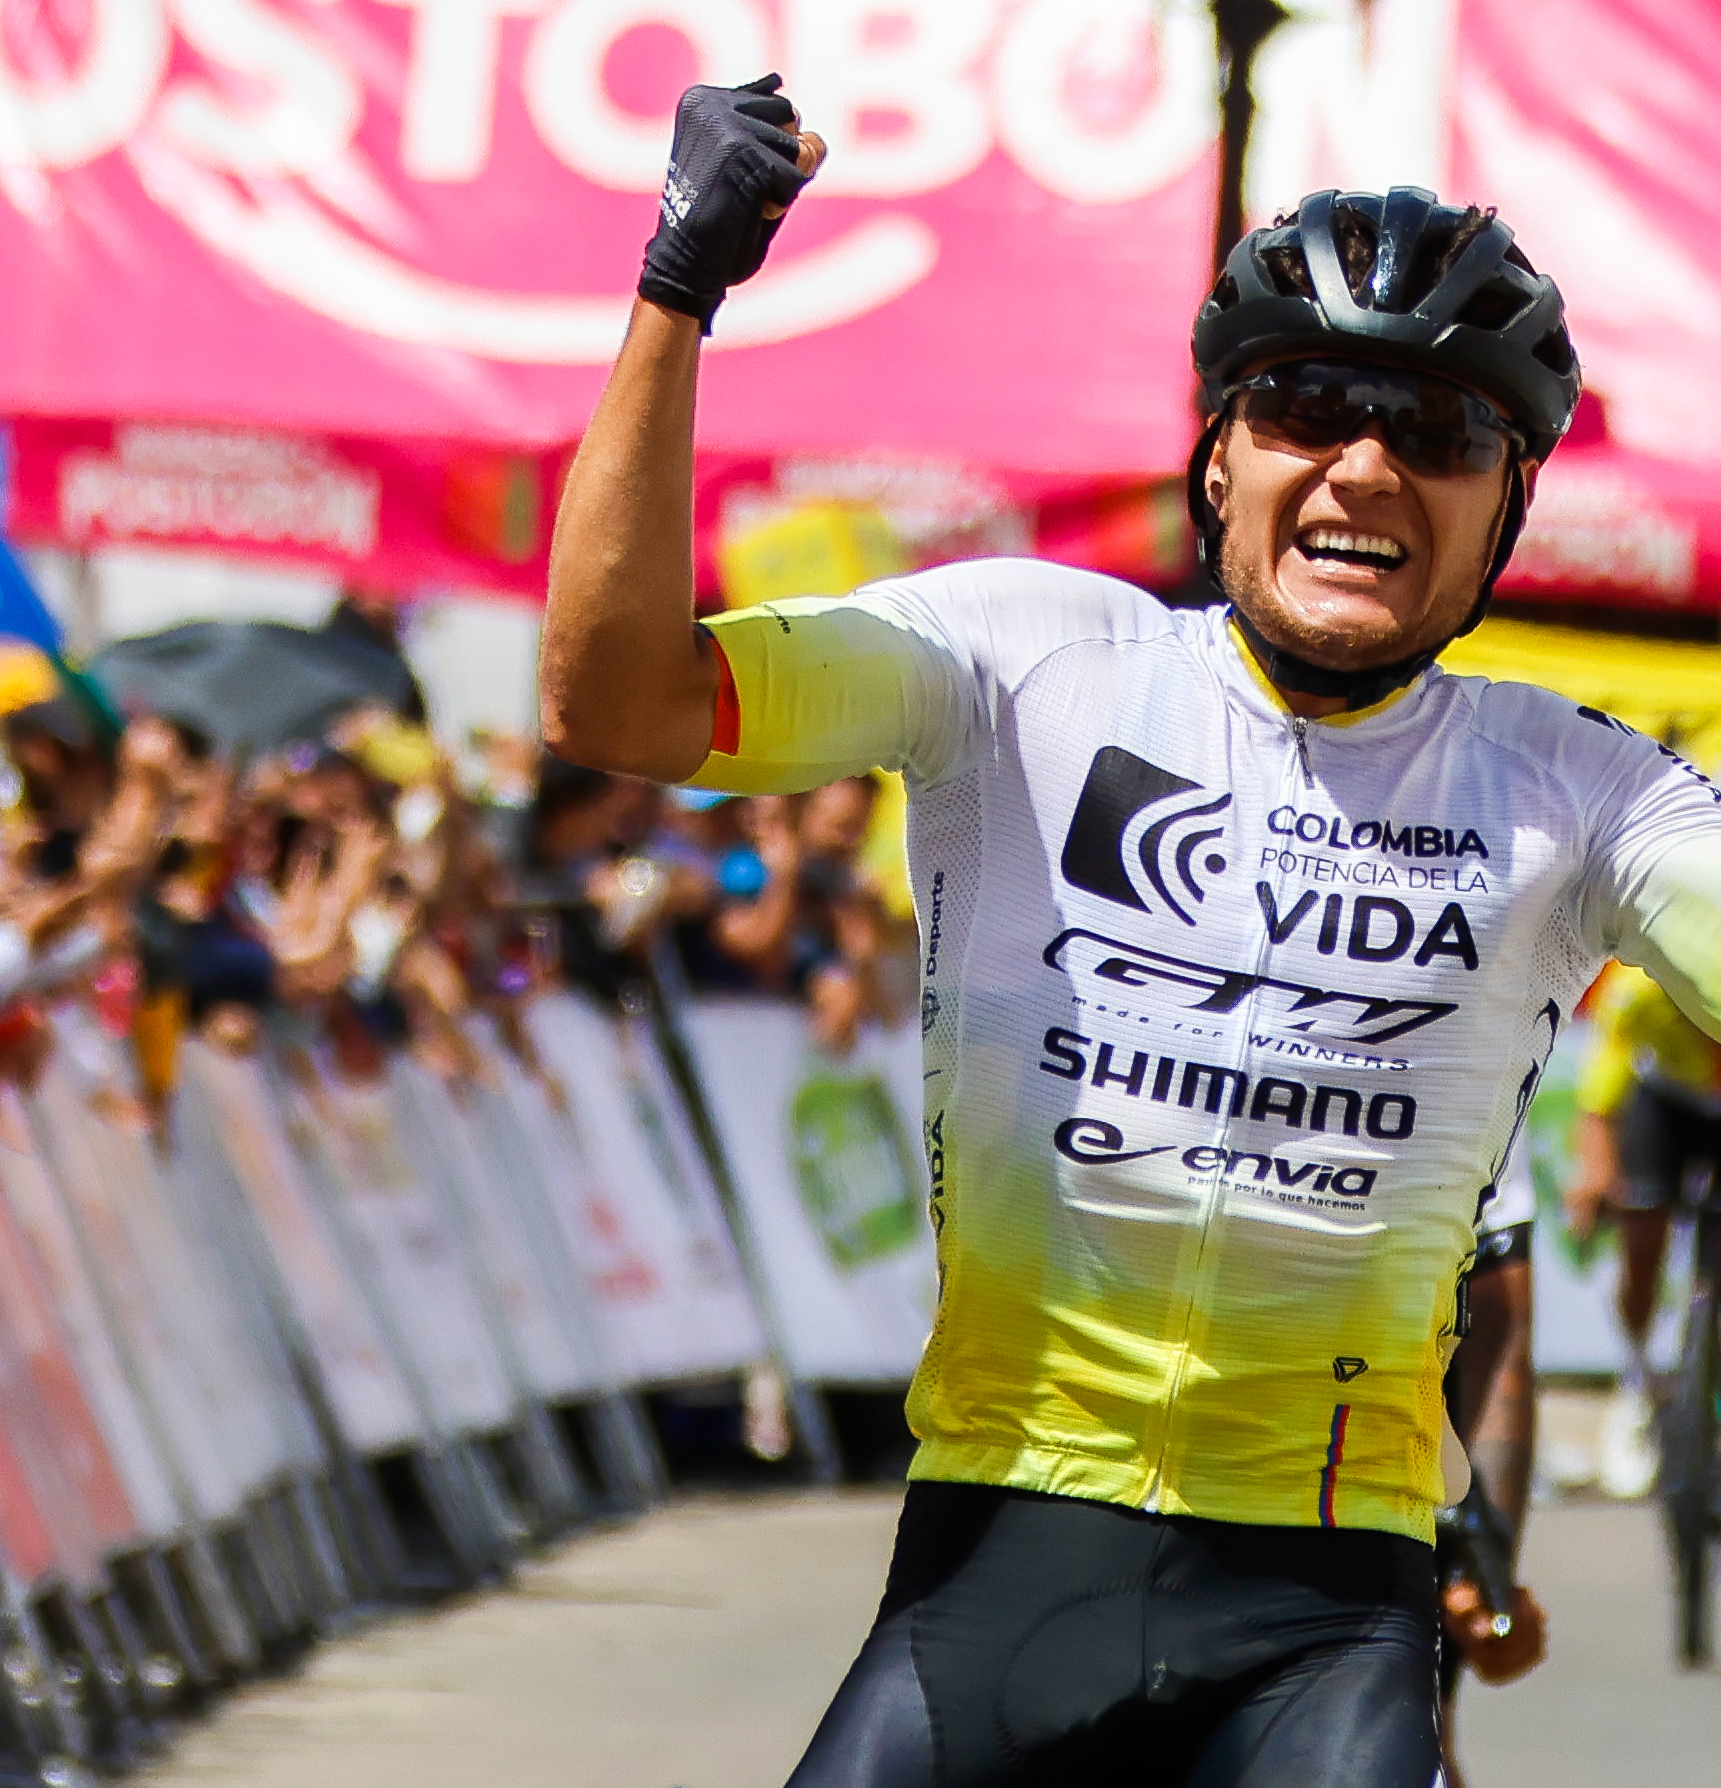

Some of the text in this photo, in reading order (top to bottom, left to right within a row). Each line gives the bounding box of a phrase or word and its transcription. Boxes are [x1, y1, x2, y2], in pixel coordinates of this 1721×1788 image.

[1260, 847, 1489, 894] POTENCIA DE LA
[1267, 805, 1489, 859] COLOMBIA
[1255, 881, 1479, 971] VIDA
[1071, 995, 1413, 1072] made for WINNERS
[1038, 1025, 1417, 1140] SHIMANO
